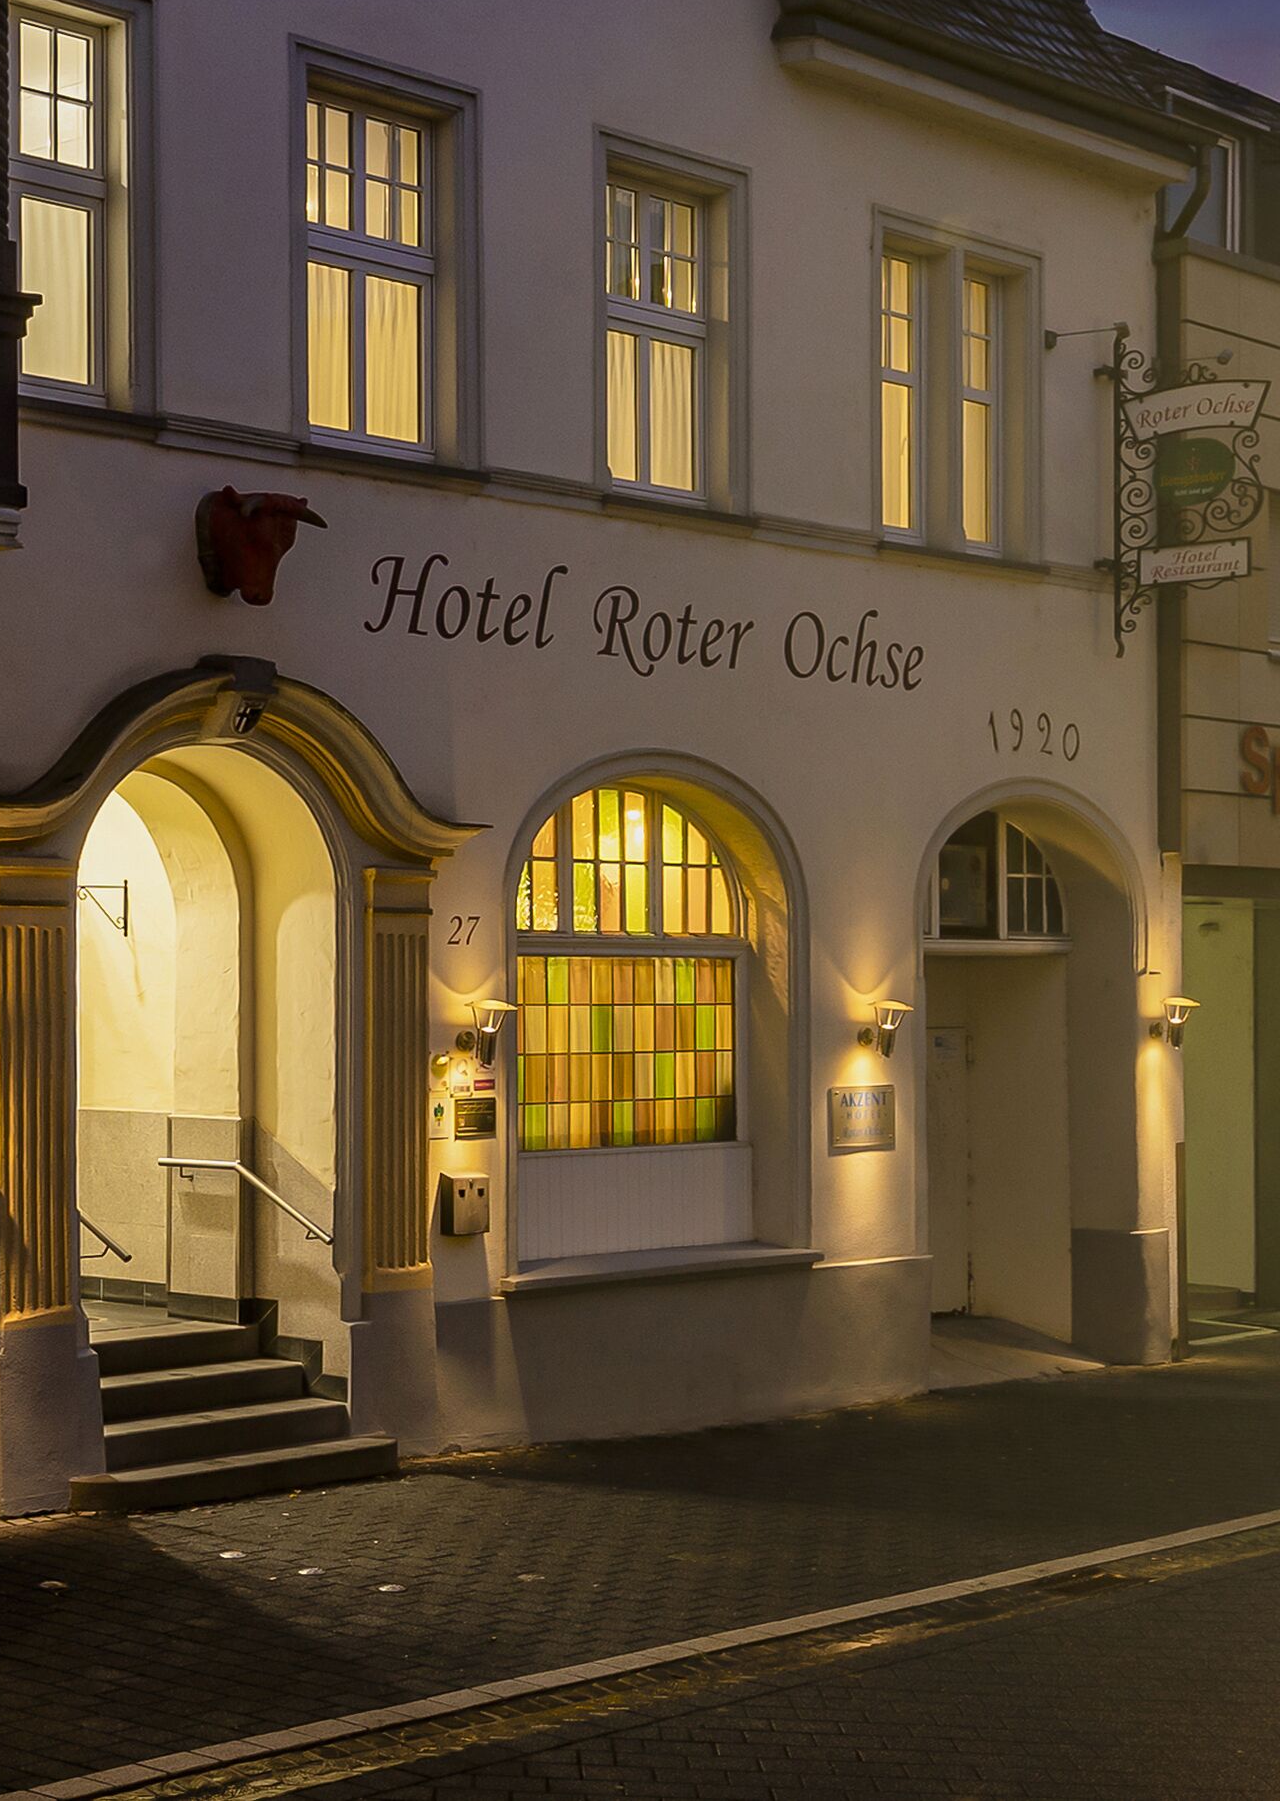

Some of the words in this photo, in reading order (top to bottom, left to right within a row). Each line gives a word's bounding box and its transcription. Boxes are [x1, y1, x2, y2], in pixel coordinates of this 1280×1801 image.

[1137, 404, 1192, 428] Roter
[1196, 393, 1255, 416] Ochse
[1152, 560, 1239, 578] Restaurant
[1173, 546, 1222, 564] Hotel
[363, 554, 568, 649] Hotel
[593, 585, 755, 677] Roter
[784, 609, 925, 691] Ochse
[988, 708, 1080, 762] 1920
[447, 915, 481, 946] 27
[840, 1092, 888, 1107] AKZENT
